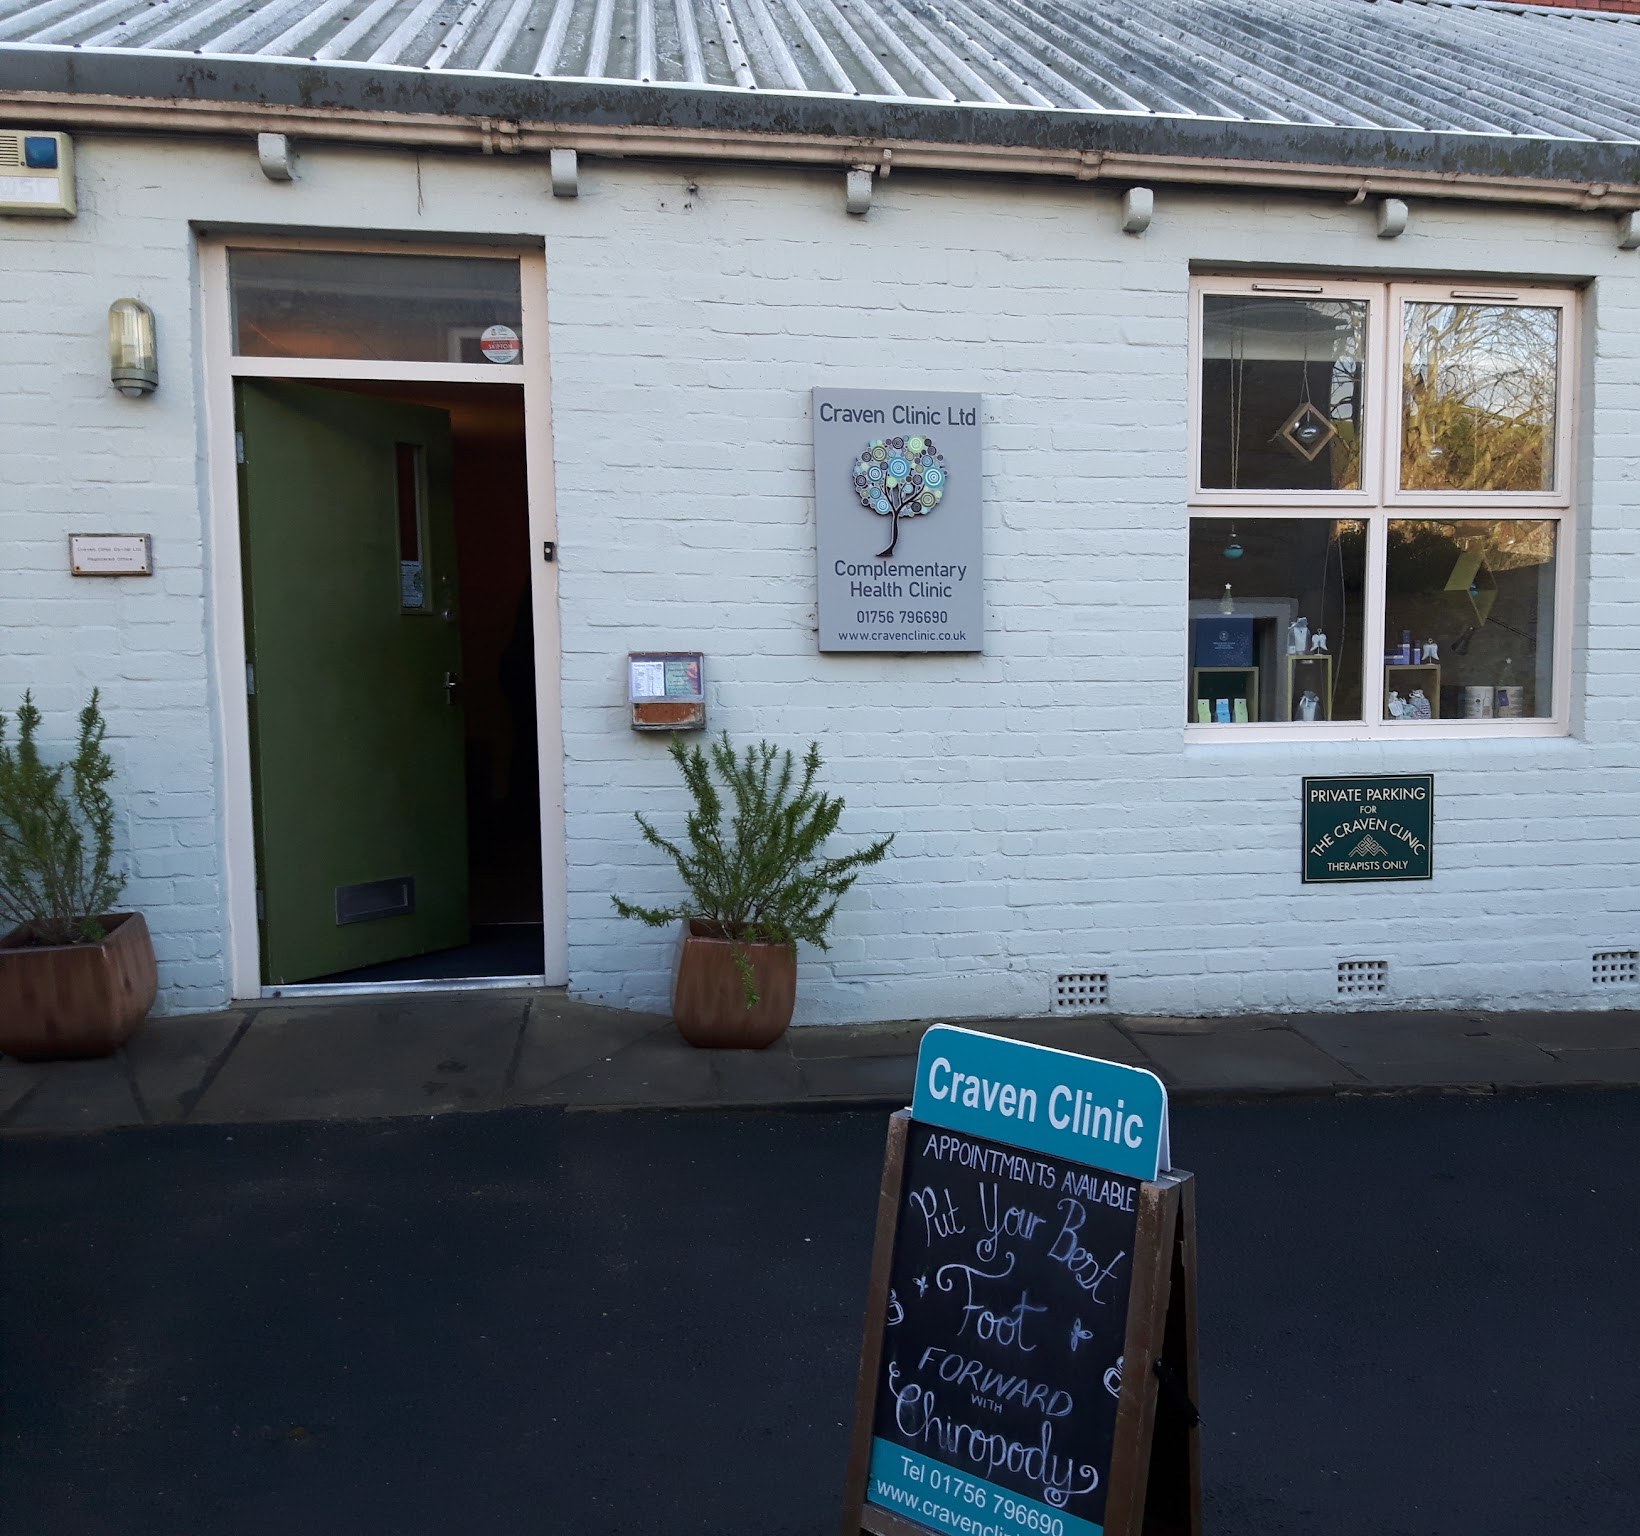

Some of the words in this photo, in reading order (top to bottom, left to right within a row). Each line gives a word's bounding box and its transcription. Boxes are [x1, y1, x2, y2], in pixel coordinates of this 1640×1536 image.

[820, 402, 885, 423] Craven
[892, 405, 941, 425] Clinic
[948, 407, 976, 426] Ltd
[835, 560, 967, 581] Complementary
[850, 581, 902, 598] Health
[909, 581, 953, 598] Clinic
[857, 610, 895, 624] 01756
[899, 610, 948, 624] 796690
[838, 630, 966, 641] www.cravenclinic.co.uk
[1311, 788, 1362, 803] PRIVATE
[1366, 786, 1426, 801] PARKING
[1359, 805, 1377, 814] FOR
[1310, 833, 1335, 857] THE
[1334, 817, 1388, 838] CRAVEN
[1389, 823, 1426, 856] CLINIC
[1327, 861, 1380, 872] THERAPISTS
[1382, 860, 1409, 870] ONLY
[928, 1056, 1037, 1123] Craven
[1048, 1084, 1144, 1149] Clinic
[922, 1133, 1056, 1189] APPOINTMENTS
[1060, 1171, 1137, 1213] AVAILABLE
[909, 1186, 966, 1248] Put
[976, 1182, 1047, 1262] Your
[1047, 1198, 1126, 1305] Best
[936, 1251, 1048, 1352] Foot
[918, 1346, 1073, 1417] FORWARD
[971, 1393, 1003, 1414] WITH
[889, 1361, 1099, 1508] Chiropody
[900, 1455, 925, 1483] Tel
[930, 1469, 986, 1508] 01756
[993, 1493, 1064, 1536] 796690
